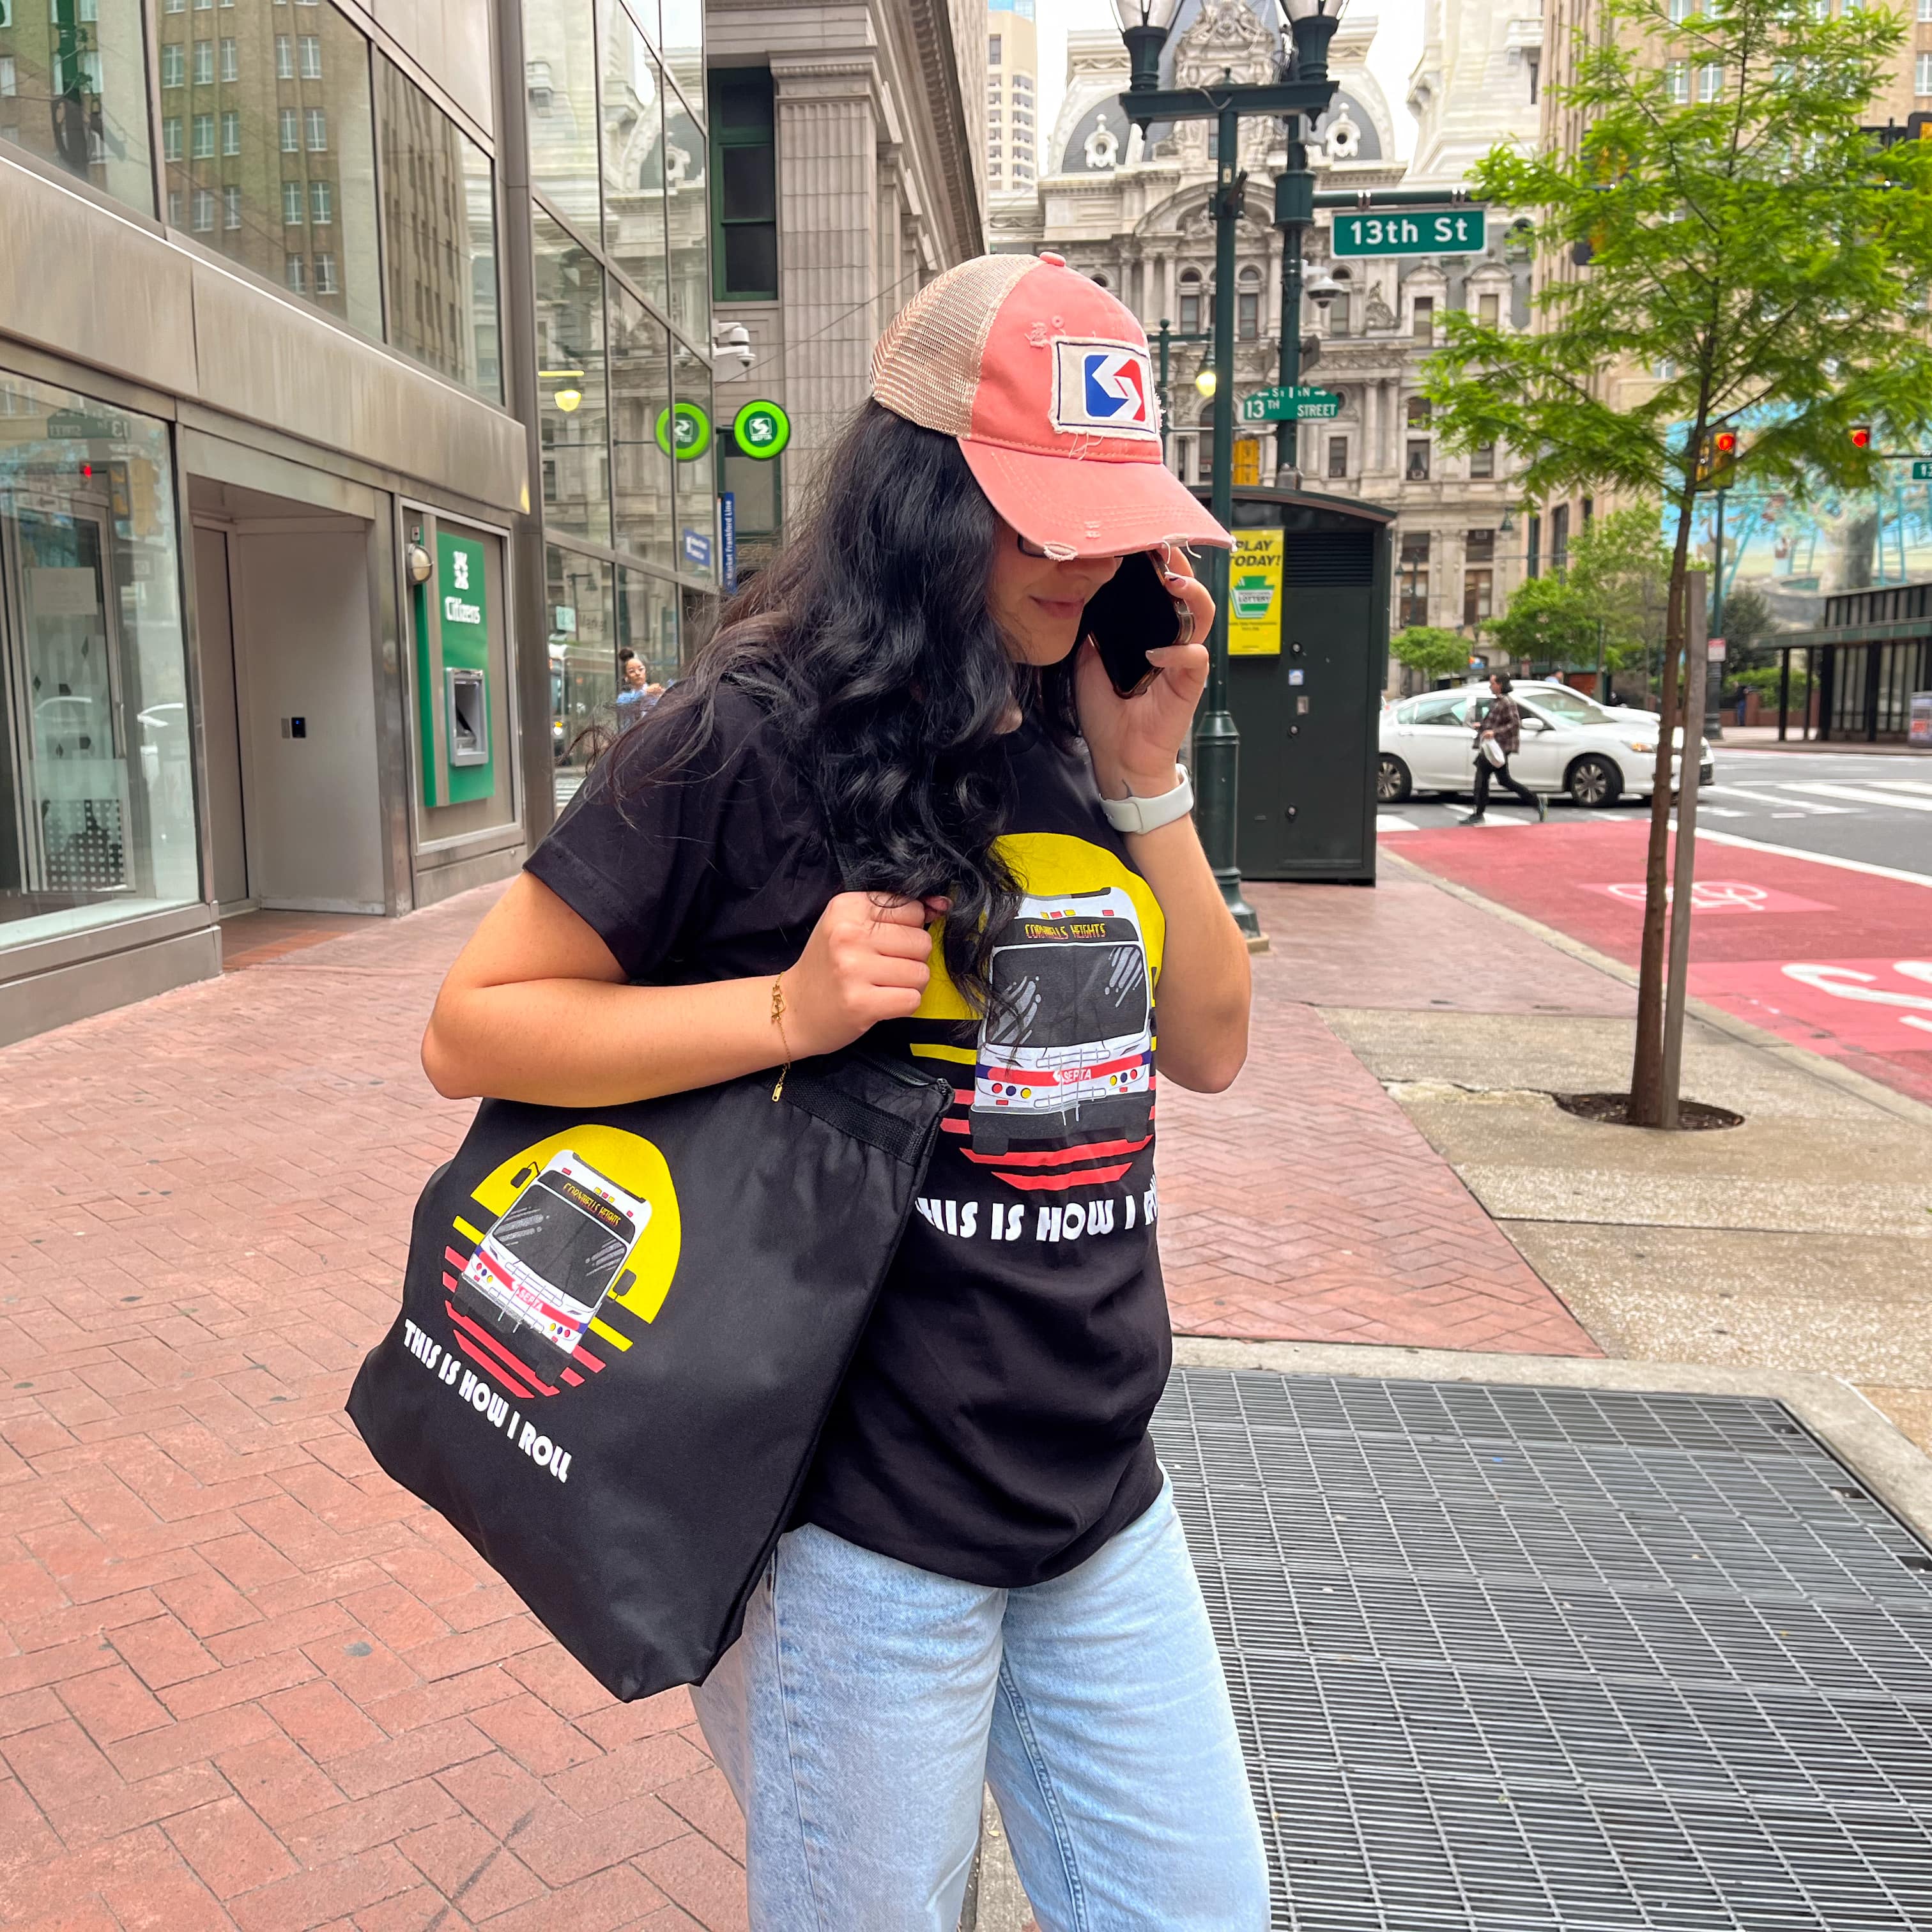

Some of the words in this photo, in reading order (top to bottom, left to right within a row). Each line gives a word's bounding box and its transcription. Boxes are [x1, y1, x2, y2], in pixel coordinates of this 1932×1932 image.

[1350, 219, 1419, 245] 13th
[1434, 217, 1468, 242] St
[1297, 403, 1337, 417] STREET
[724, 500, 733, 516] Line
[724, 518, 733, 553] Frankford
[1236, 540, 1273, 551] PLAY
[445, 595, 480, 624] Citizens
[1063, 1068, 1092, 1084] SEPTA
[990, 1202, 1025, 1241] IS
[1036, 1199, 1114, 1242] HOW
[1124, 1195, 1136, 1230] I
[518, 1289, 544, 1312] SEPTA
[404, 1318, 442, 1369] THIS
[438, 1352, 461, 1385] IS
[458, 1368, 510, 1427] HOW
[507, 1410, 521, 1440] I
[518, 1420, 572, 1483] ROLL
